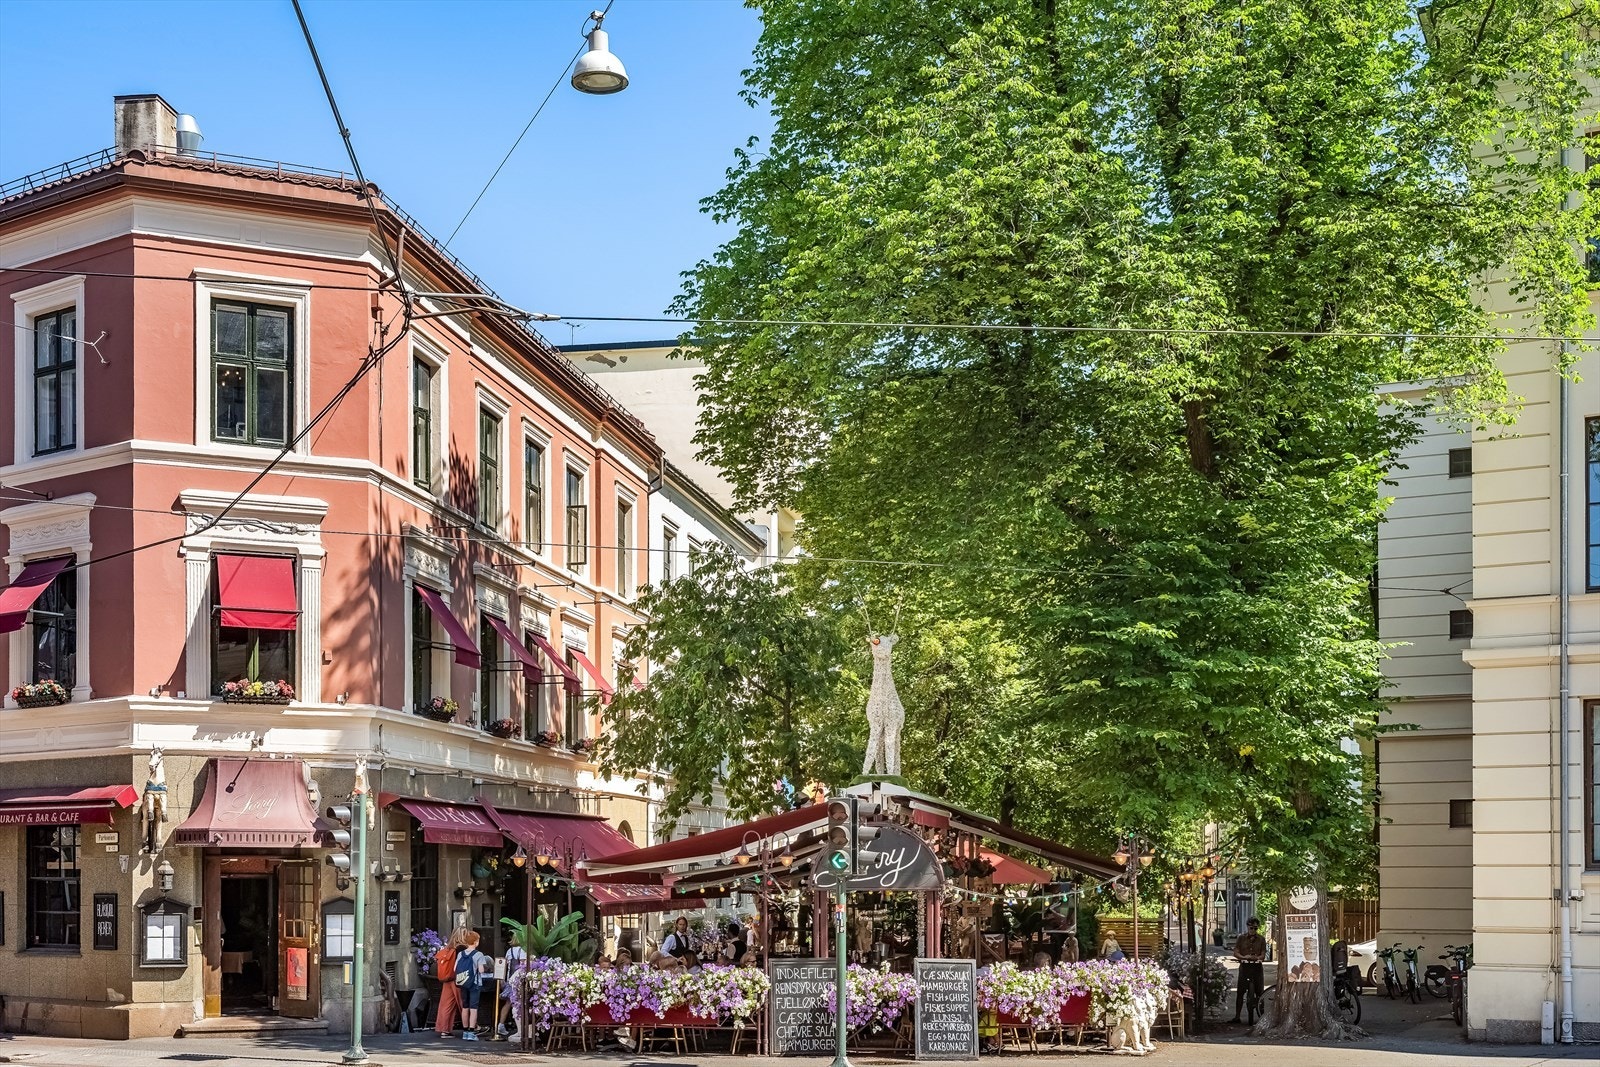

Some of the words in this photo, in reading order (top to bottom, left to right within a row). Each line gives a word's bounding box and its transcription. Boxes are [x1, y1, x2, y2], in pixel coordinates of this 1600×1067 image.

[27, 813, 33, 823] &
[35, 812, 50, 823] BAR
[51, 811, 58, 822] &
[776, 967, 837, 980] INDREFILET
[922, 981, 969, 992] HAMBURGER
[926, 993, 944, 1002] FISH
[949, 993, 970, 1002] CHIPS
[779, 1012, 814, 1025] CÆSAR
[928, 1032, 942, 1041] EGG
[947, 1033, 970, 1041] BACON
[779, 1039, 836, 1051] HAMBURGER
[928, 1042, 968, 1052] KARBONADE
